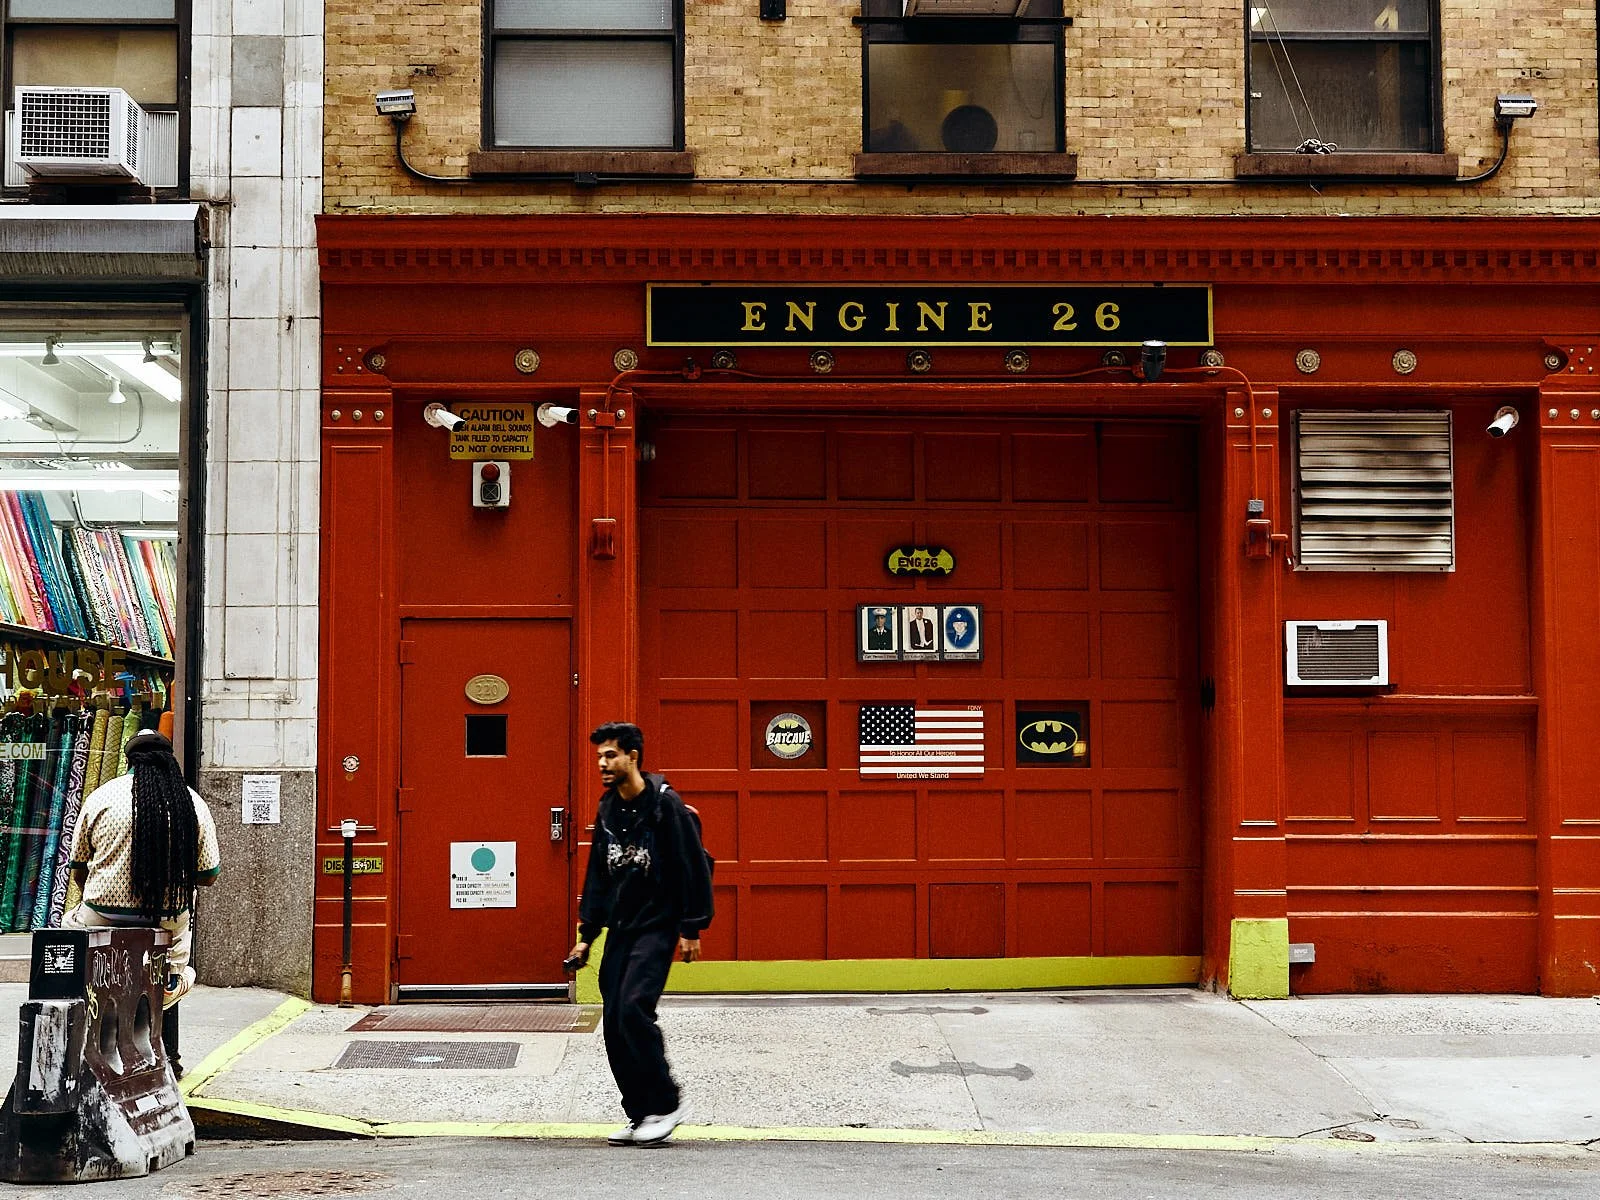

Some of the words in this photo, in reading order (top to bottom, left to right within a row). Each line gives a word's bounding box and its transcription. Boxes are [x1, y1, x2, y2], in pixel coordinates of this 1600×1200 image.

[740, 301, 993, 332] ENGINE
[1052, 302, 1121, 332] 26
[459, 408, 525, 421] CAUTION
[470, 424, 490, 432] ALARM
[492, 424, 506, 432] BELL
[508, 424, 532, 432] SOUNDS
[455, 434, 470, 443] TANK
[471, 434, 490, 443] FILLED
[491, 434, 500, 443] TO
[501, 434, 529, 443] CAPACITY
[451, 445, 465, 453] DO
[468, 445, 487, 453] NOT
[490, 445, 532, 453] OVERFILL
[898, 557, 922, 568] ENG
[923, 557, 938, 568] 26
[766, 730, 811, 746] BATCAVE
